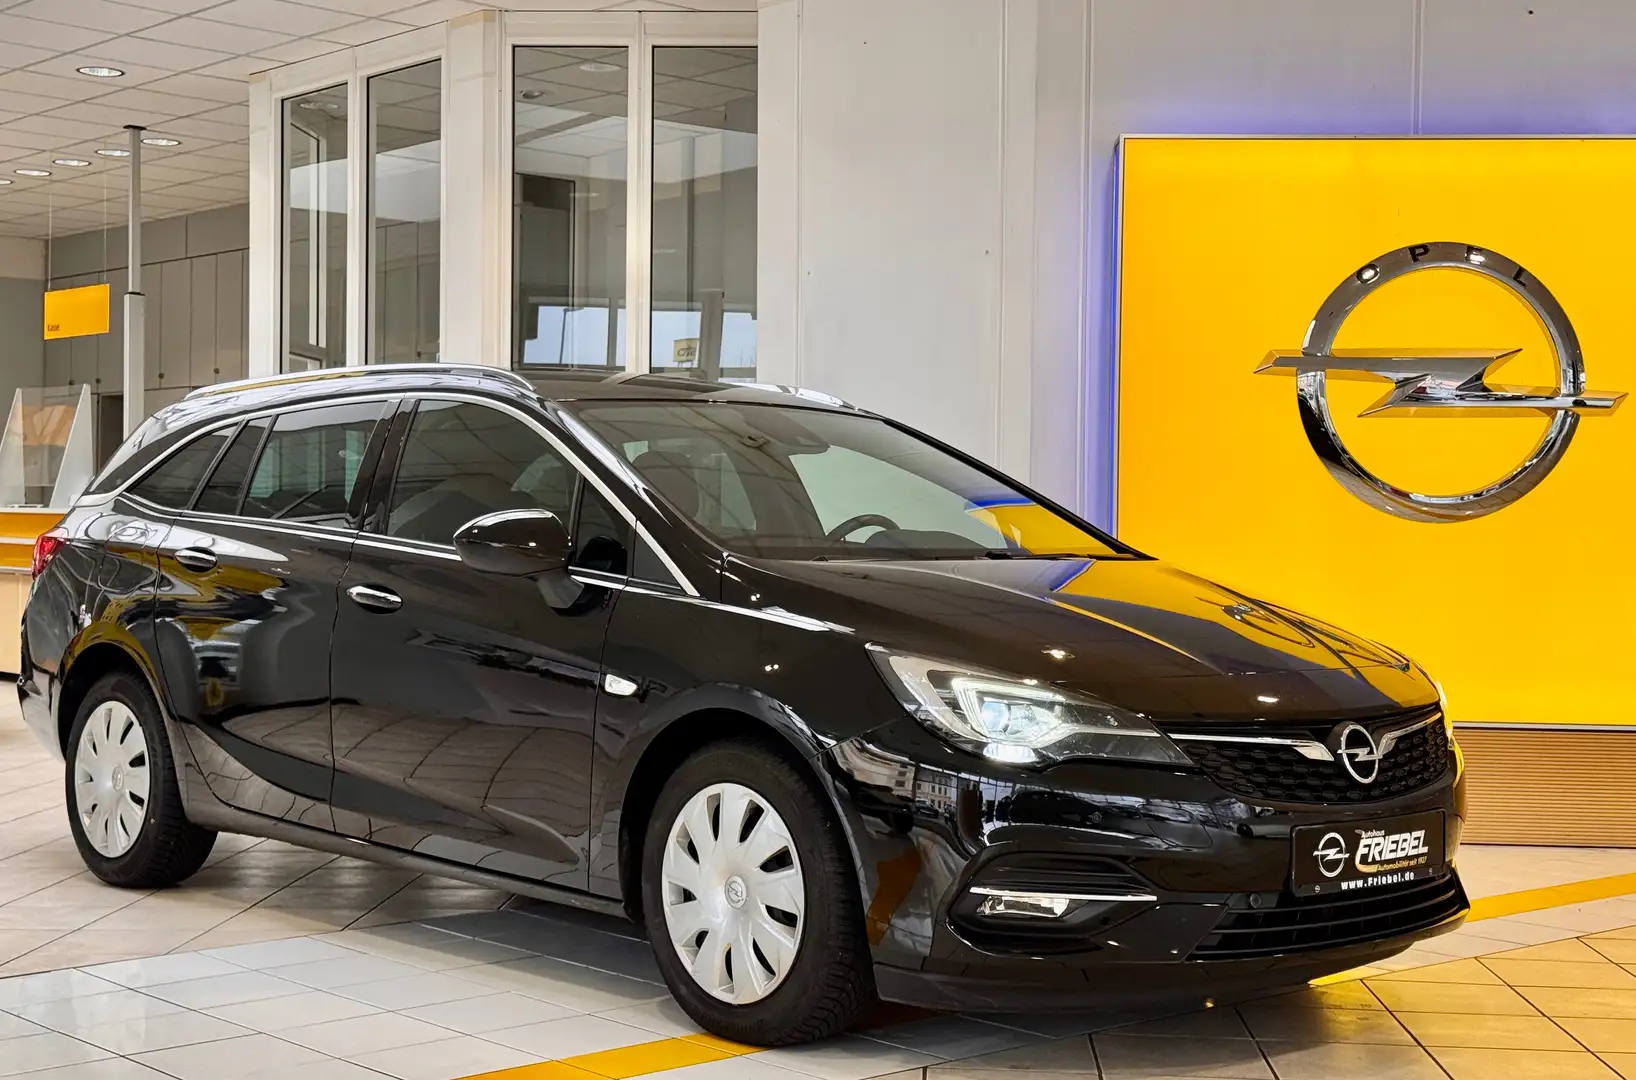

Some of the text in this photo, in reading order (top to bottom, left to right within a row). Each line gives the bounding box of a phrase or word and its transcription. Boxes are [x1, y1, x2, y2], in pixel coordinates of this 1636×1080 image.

[1356, 244, 1527, 287] OPEL
[1361, 829, 1385, 838] Autohaus
[1355, 830, 1429, 864] FRIEBEL
[1341, 871, 1415, 890] www.Friebel.de
